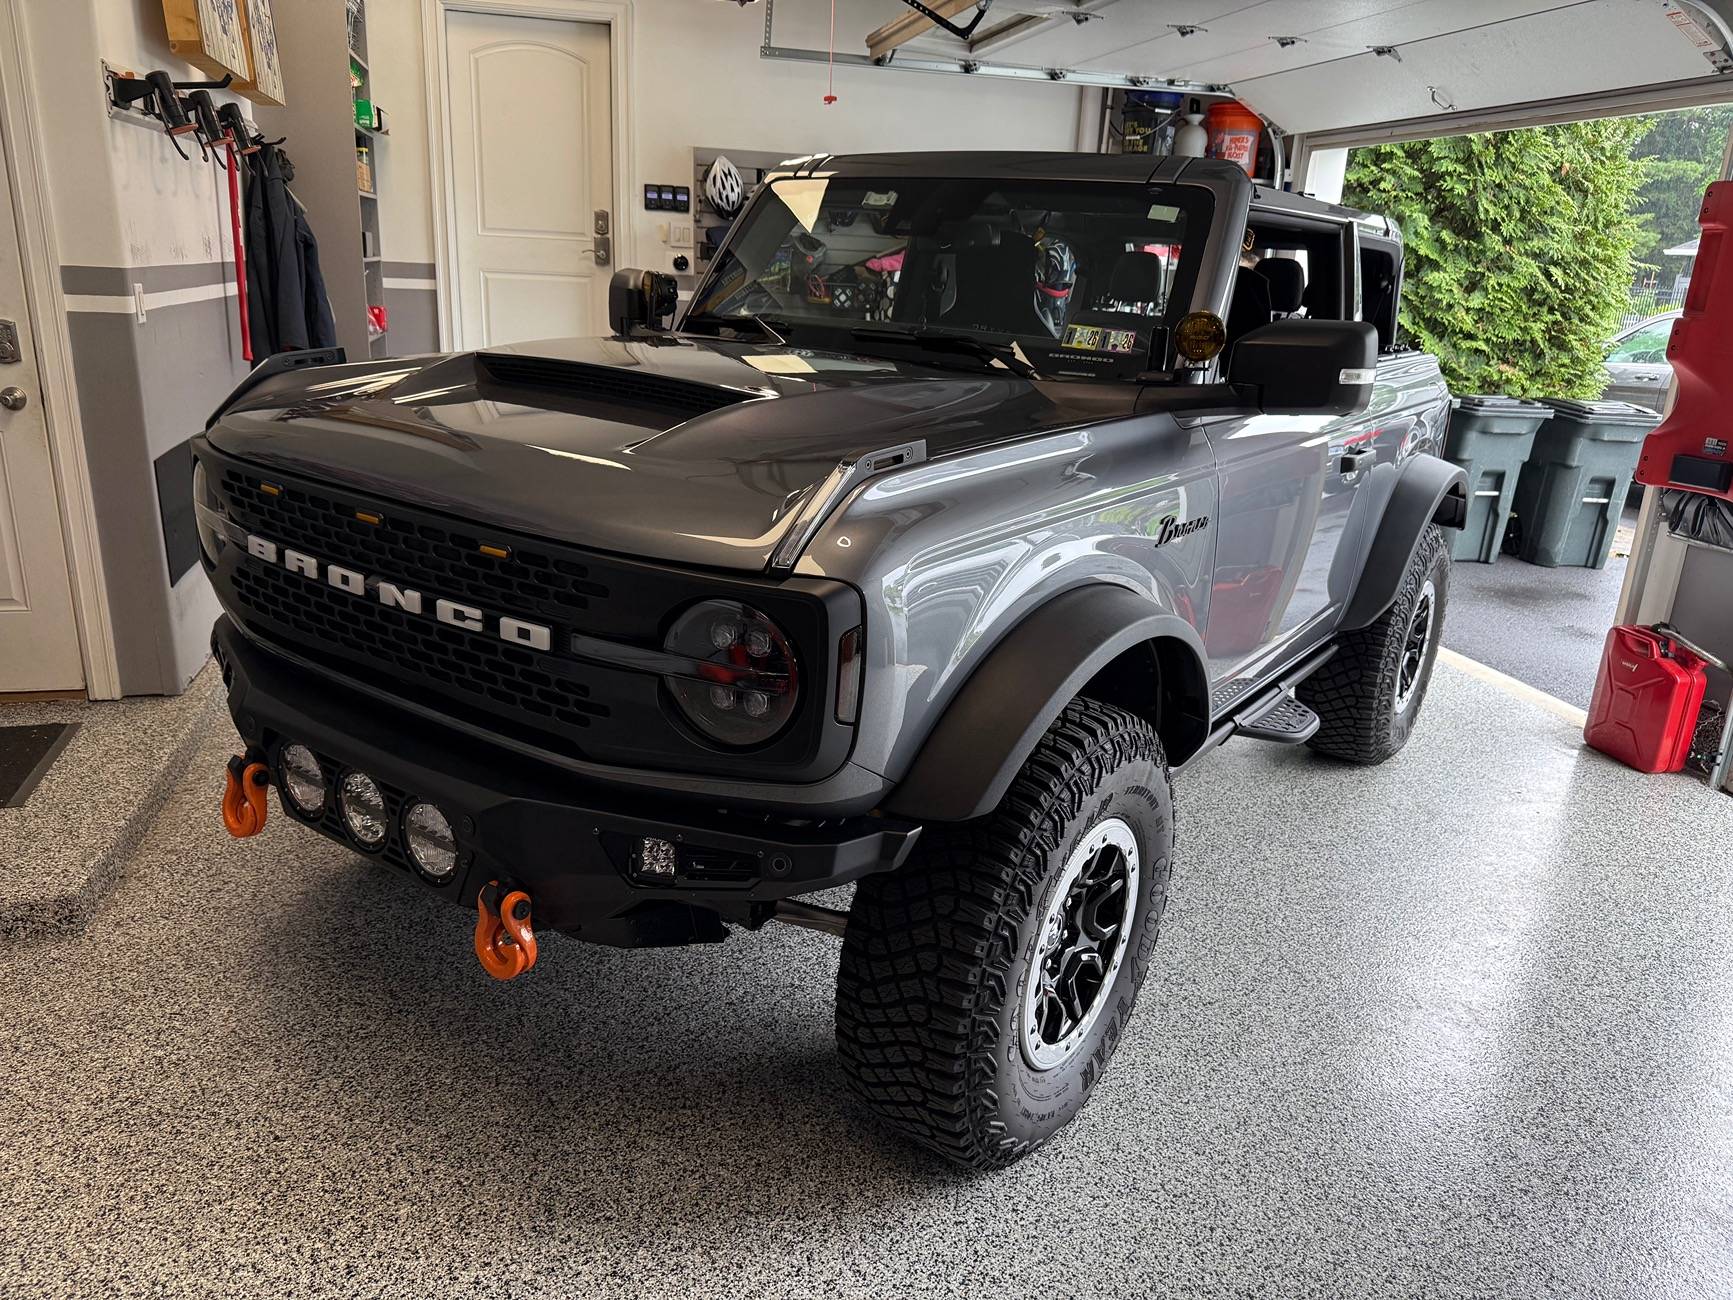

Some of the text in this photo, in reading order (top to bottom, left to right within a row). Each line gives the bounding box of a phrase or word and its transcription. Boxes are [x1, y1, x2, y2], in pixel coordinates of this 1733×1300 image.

[1087, 330, 1099, 346] 26
[1122, 333, 1134, 350] 26
[247, 534, 551, 651] BRONCO
